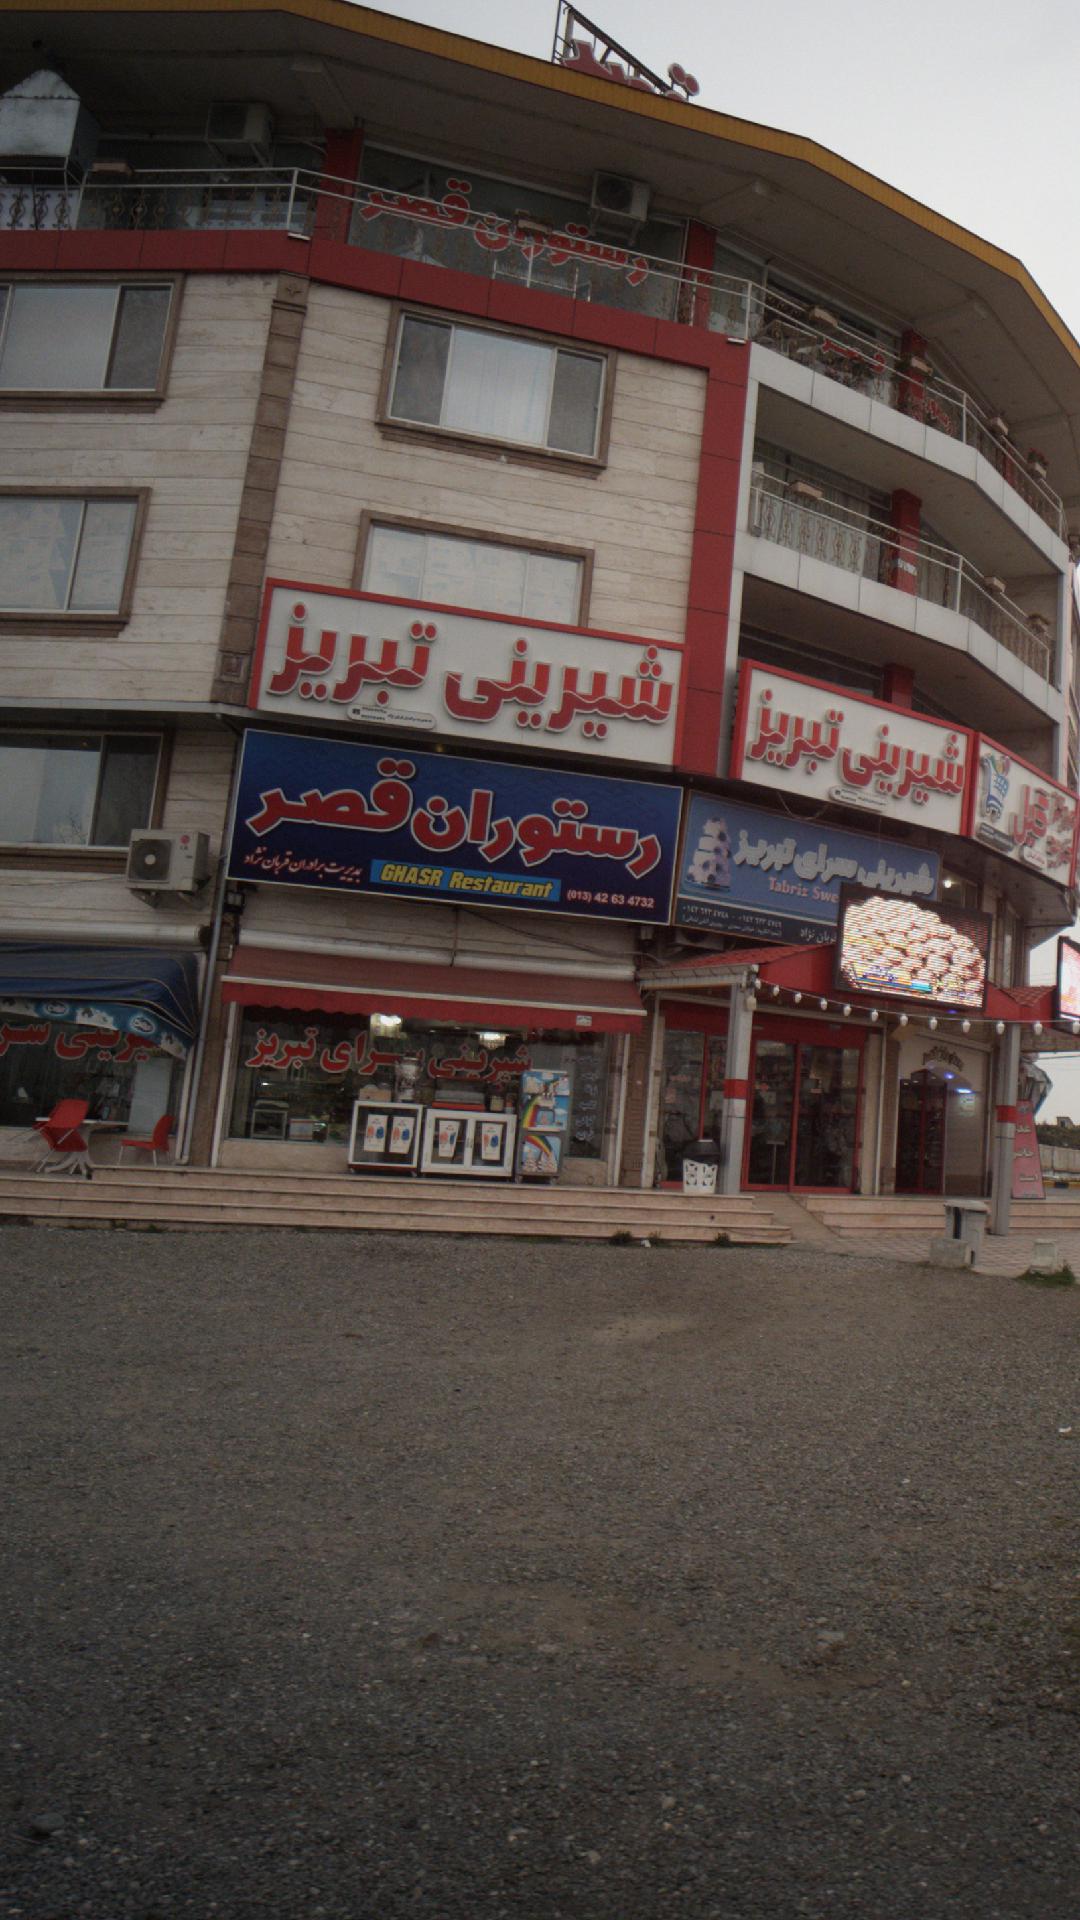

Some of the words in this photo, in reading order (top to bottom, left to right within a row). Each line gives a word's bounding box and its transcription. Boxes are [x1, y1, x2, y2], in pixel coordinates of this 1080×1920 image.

[266, 601, 439, 707] تبریز
[443, 645, 675, 741] شیرینی
[748, 688, 844, 775] تبریز
[840, 724, 964, 804] شیرینی
[245, 757, 416, 837] قصر
[411, 788, 662, 879] رستوران
[733, 829, 797, 872] تبریز
[381, 863, 443, 888] GHASR
[448, 871, 554, 899] Restaurant
[794, 843, 858, 884] سرای
[566, 889, 592, 903] (013)
[594, 892, 609, 905] 42
[612, 894, 625, 906] 63
[627, 895, 655, 909] 4732
[768, 876, 808, 898] Tabriz
[811, 885, 840, 902] Swe
[246, 1027, 319, 1067] تبریز
[428, 1043, 533, 1090] شیرینی
